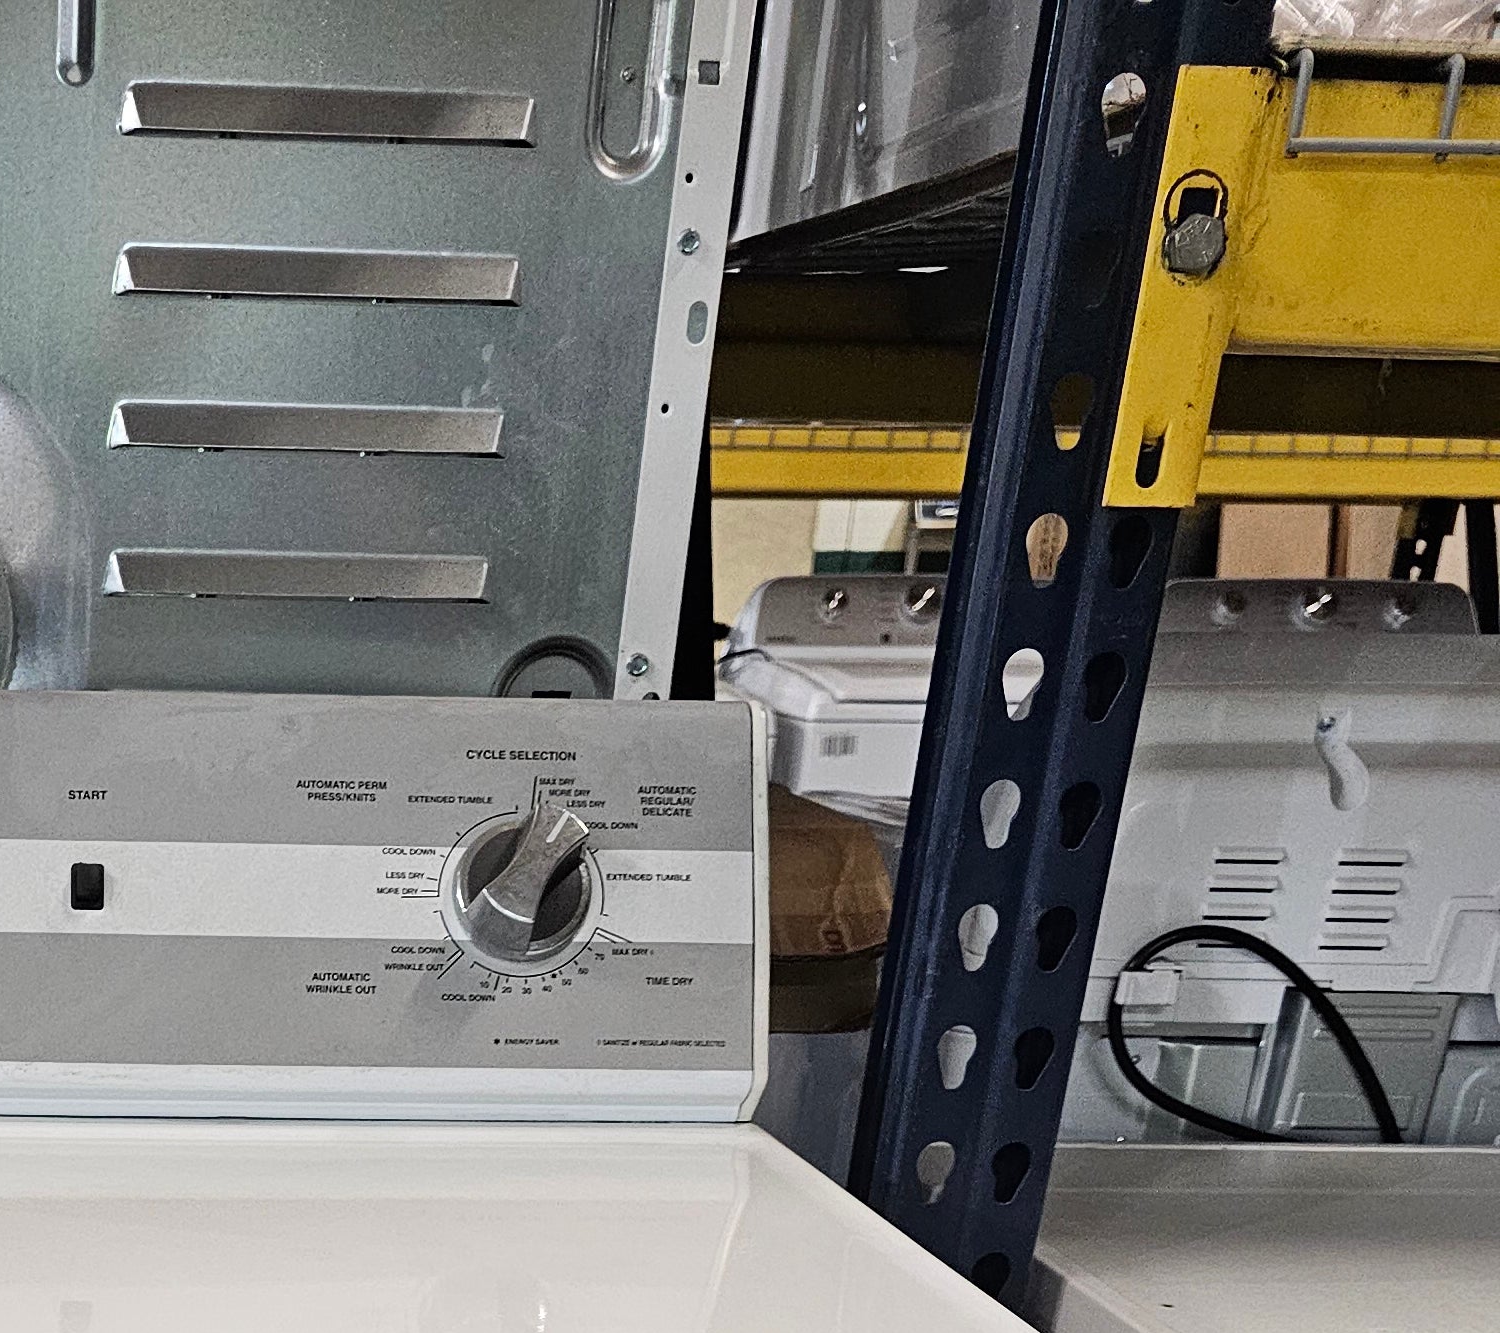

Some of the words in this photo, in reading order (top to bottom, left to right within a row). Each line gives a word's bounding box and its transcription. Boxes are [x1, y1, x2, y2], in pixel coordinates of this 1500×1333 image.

[466, 750, 506, 761] CYCLE
[509, 750, 577, 762] SELECTION
[296, 780, 357, 791] AUTOMATIC
[358, 781, 388, 791] PERM
[539, 777, 557, 785] MAX
[559, 777, 576, 786] DRY
[549, 789, 573, 797] MORE
[574, 789, 591, 797] DRY
[637, 785, 697, 795] AUTOMATIC
[68, 790, 108, 800] START
[307, 792, 377, 803] PRESS/KNITS
[408, 795, 456, 805] EXTENDED
[458, 796, 493, 805] TUMBLE
[566, 800, 587, 808] LESS
[589, 800, 606, 809] DRY
[640, 796, 696, 806] REGULAR/
[642, 807, 693, 818] DELICATE
[585, 822, 608, 830] COOL
[611, 822, 639, 830] DOWN
[382, 847, 408, 856] COOL
[409, 848, 437, 856] DOWN
[385, 871, 407, 880] LESS
[408, 872, 426, 880] DRY
[606, 873, 653, 881] EXTENDED
[655, 873, 692, 882] TUMBLE
[377, 887, 401, 895] MORE
[402, 887, 419, 895] DRY
[391, 946, 414, 955] COOL
[417, 946, 446, 955] DOWN
[632, 948, 649, 956] DRY
[384, 963, 424, 972] WRINKLE
[425, 963, 444, 972] OUT
[312, 972, 371, 983] AUTOMATIC
[646, 976, 671, 986] TIME
[672, 977, 694, 987] DRY
[305, 983, 353, 994] WRINKLE
[354, 985, 377, 995] OUT
[502, 986, 512, 994] 20
[521, 987, 532, 995] 30
[441, 994, 466, 1002] COOL
[468, 994, 497, 1002] DOWN
